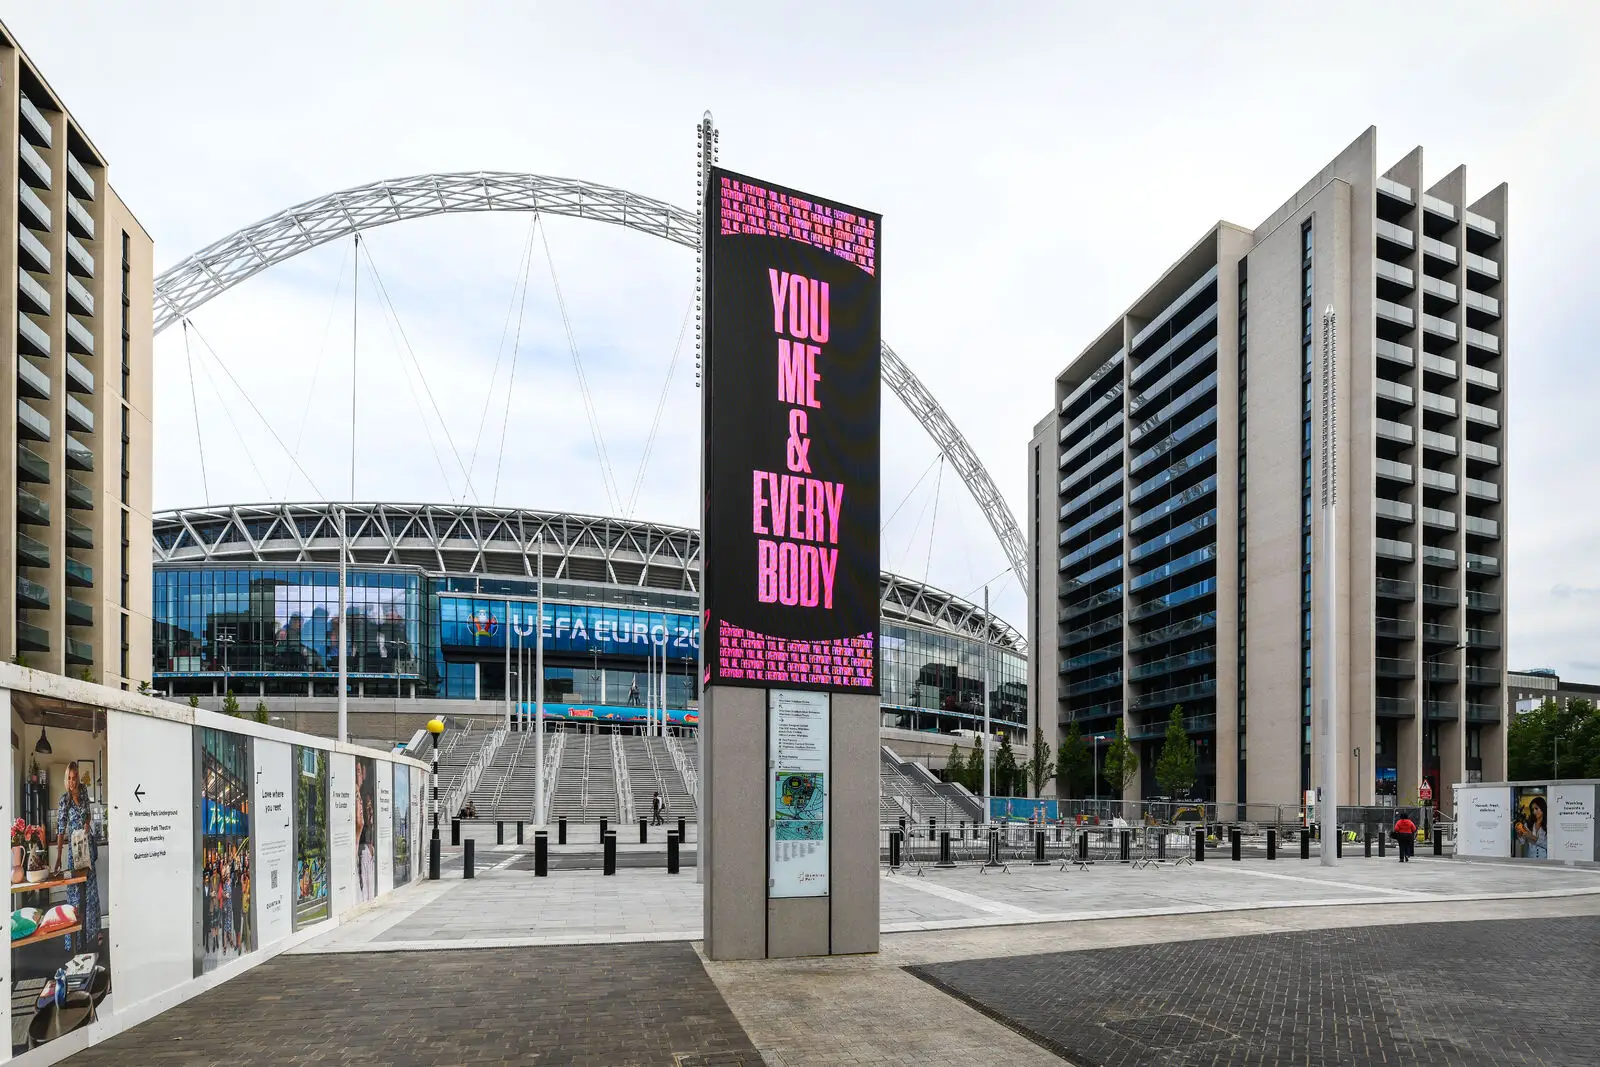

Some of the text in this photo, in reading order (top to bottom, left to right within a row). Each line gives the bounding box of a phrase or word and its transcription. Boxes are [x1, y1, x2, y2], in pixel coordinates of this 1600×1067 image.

[768, 268, 829, 343] YOU
[777, 338, 821, 409] ME
[786, 408, 812, 474] &
[752, 469, 844, 544] EVERY
[758, 539, 839, 610] BODY
[513, 614, 590, 640] UEFA
[594, 621, 669, 646] EURO
[158, 809, 178, 817] Underground
[262, 789, 284, 798] Love where
[265, 804, 282, 813] you rent
[149, 834, 165, 842] Wembley
